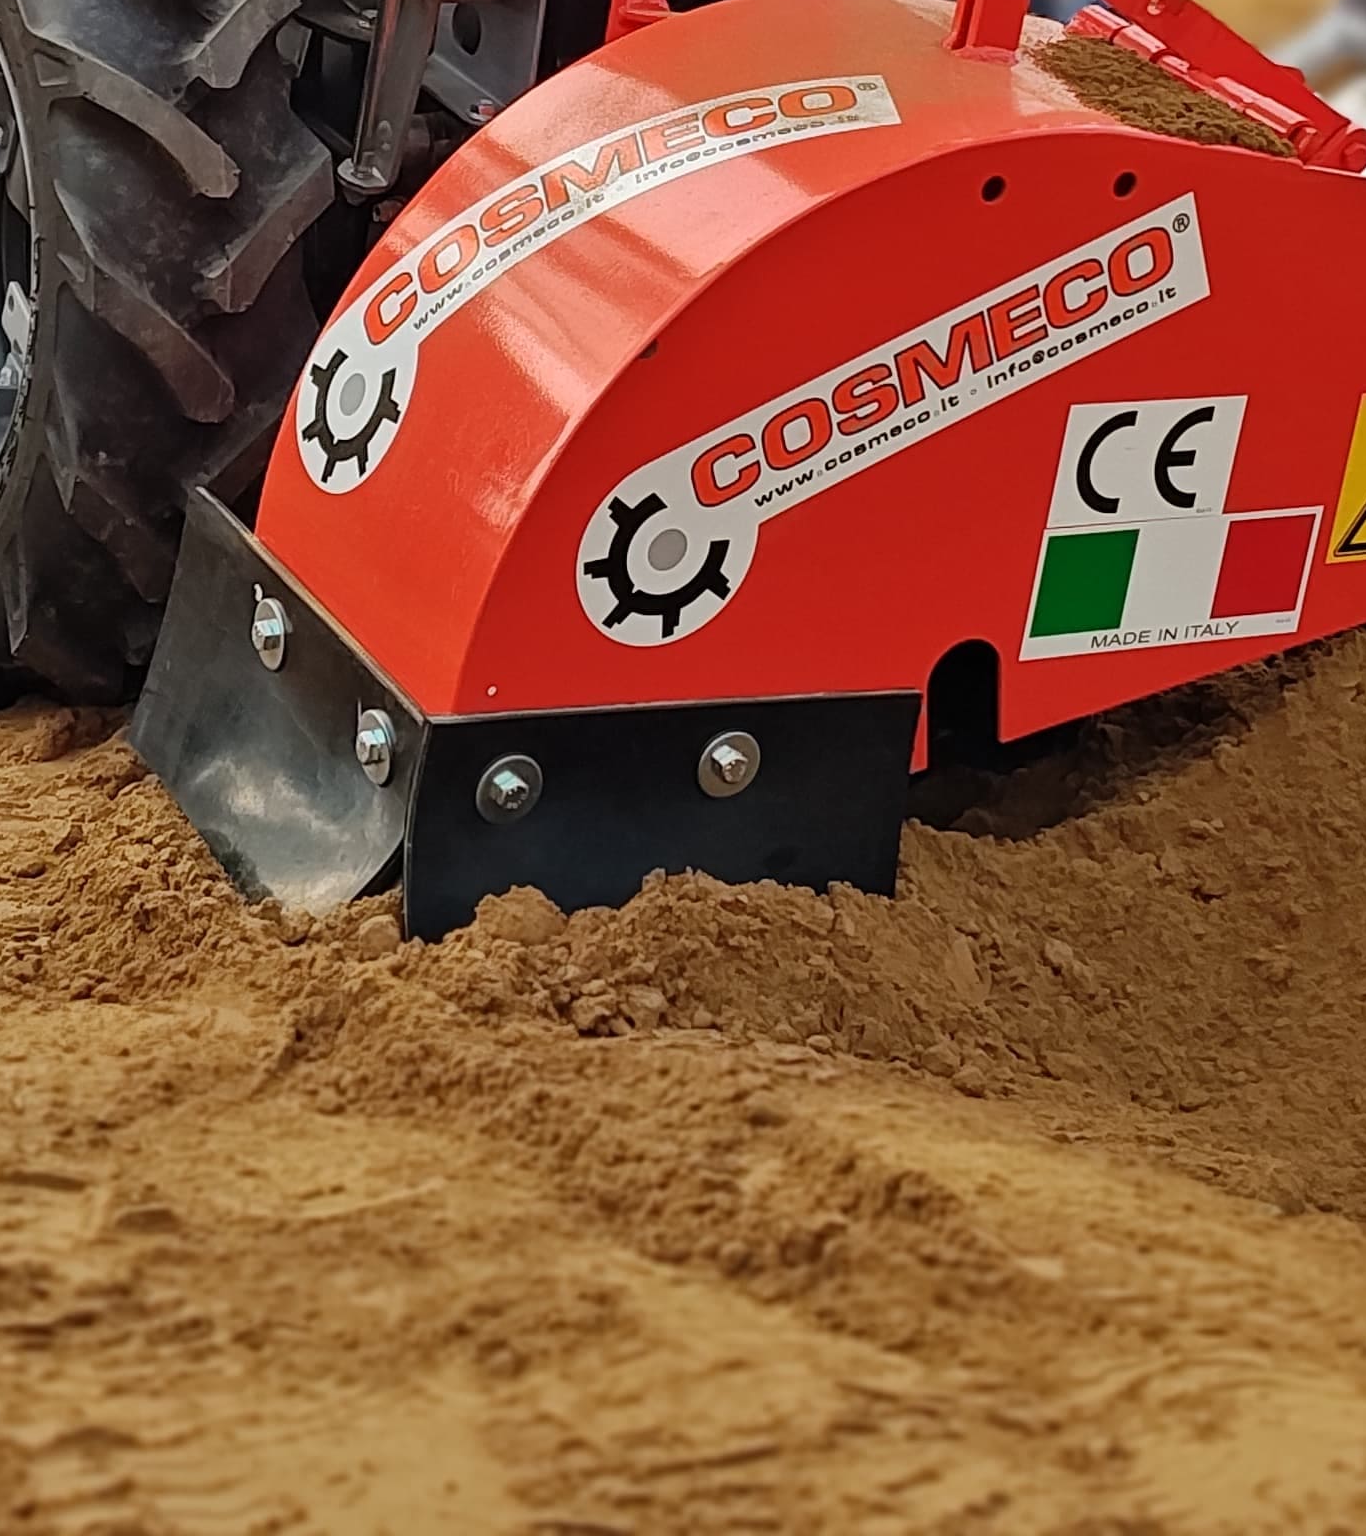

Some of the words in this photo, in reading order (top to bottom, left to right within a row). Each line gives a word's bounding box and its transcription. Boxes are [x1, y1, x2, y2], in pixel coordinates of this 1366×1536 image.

[1075, 405, 1216, 514] CE
[1090, 629, 1152, 649] MADE
[1157, 626, 1179, 642] IN
[1184, 620, 1240, 640] ITALY
